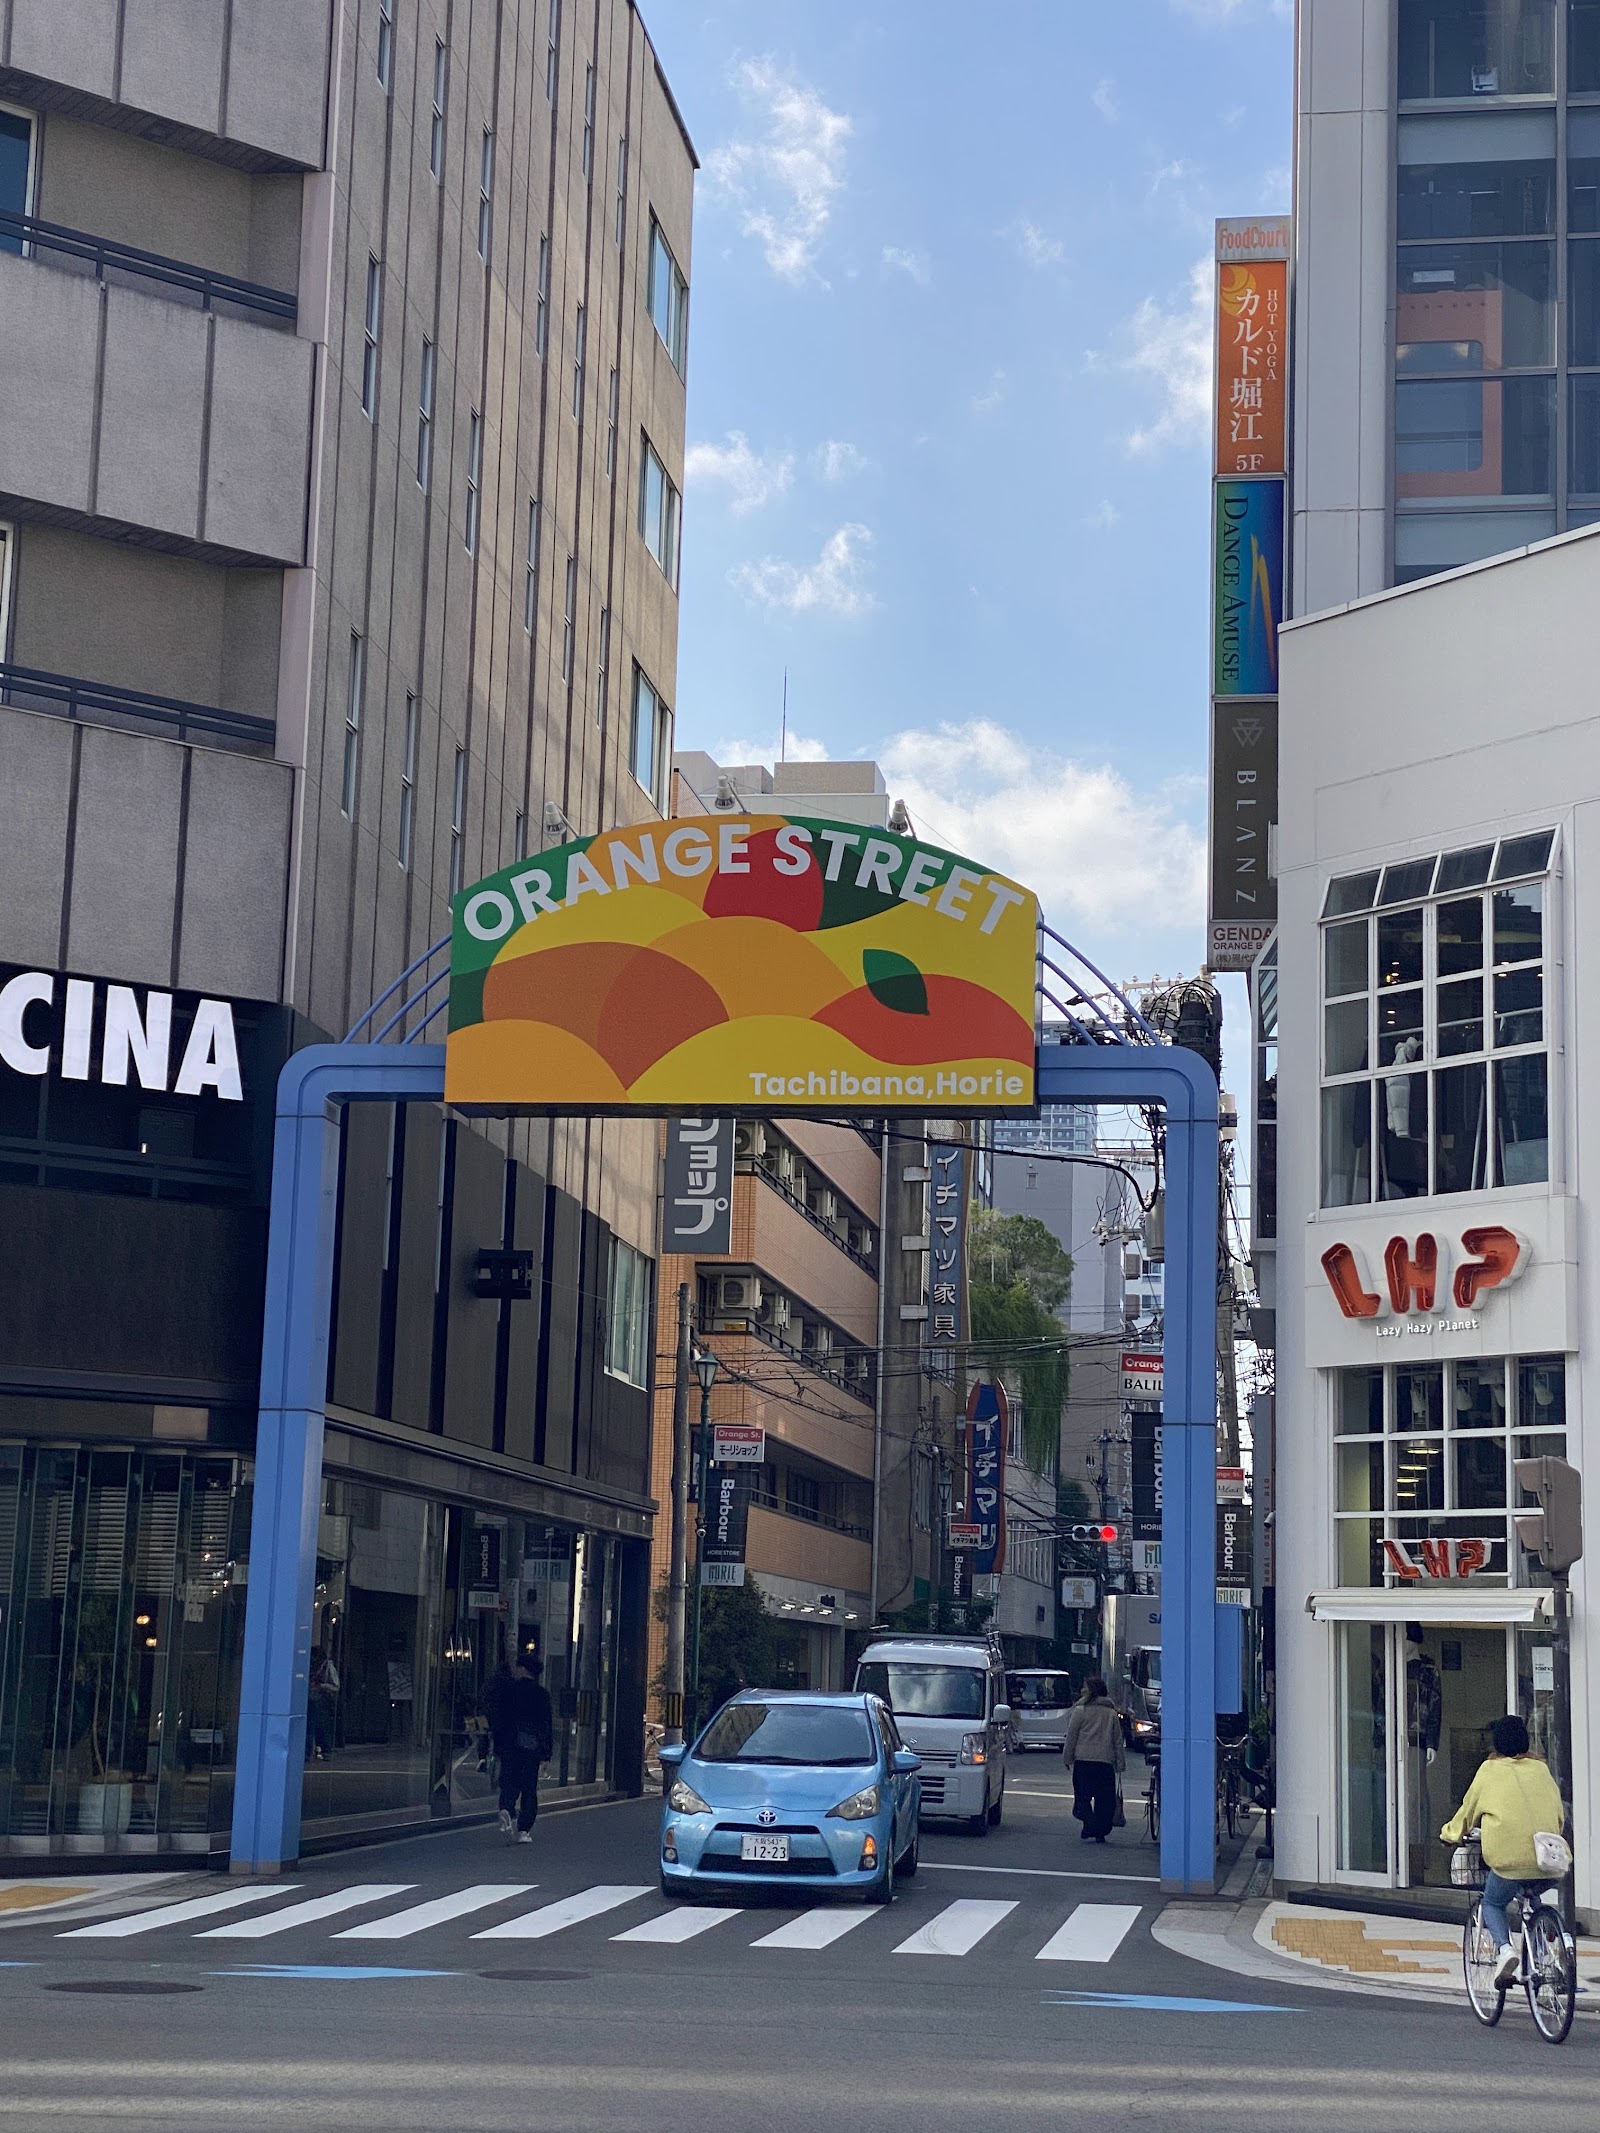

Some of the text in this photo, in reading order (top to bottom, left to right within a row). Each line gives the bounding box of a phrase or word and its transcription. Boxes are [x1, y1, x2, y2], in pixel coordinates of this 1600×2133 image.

[1219, 225, 1288, 249] FoodCourt
[1266, 289, 1278, 380] HOT YOGA
[1230, 288, 1263, 443] カルド堀江
[1236, 454, 1264, 471] 5F
[1222, 496, 1249, 682] DANCE AMUSE
[1236, 769, 1257, 903] BLANZ
[463, 823, 1026, 941] ORANGE STREET
[1213, 942, 1253, 950] ORANGE
[0, 972, 243, 1101] CINA
[933, 1150, 959, 1339] イチマツ家具
[1321, 1225, 1526, 1319] LHP
[1376, 1319, 1478, 1337] Lazy Hazy Planet
[718, 1429, 749, 1439] Orange
[719, 1444, 759, 1456] モーリショップ
[718, 1478, 735, 1543] Barbour
[1224, 1513, 1237, 1570] Barbour
[1383, 1538, 1489, 1579] LHP
[953, 1556, 964, 1596] Barbour
[754, 1845, 786, 1859] 12-23
